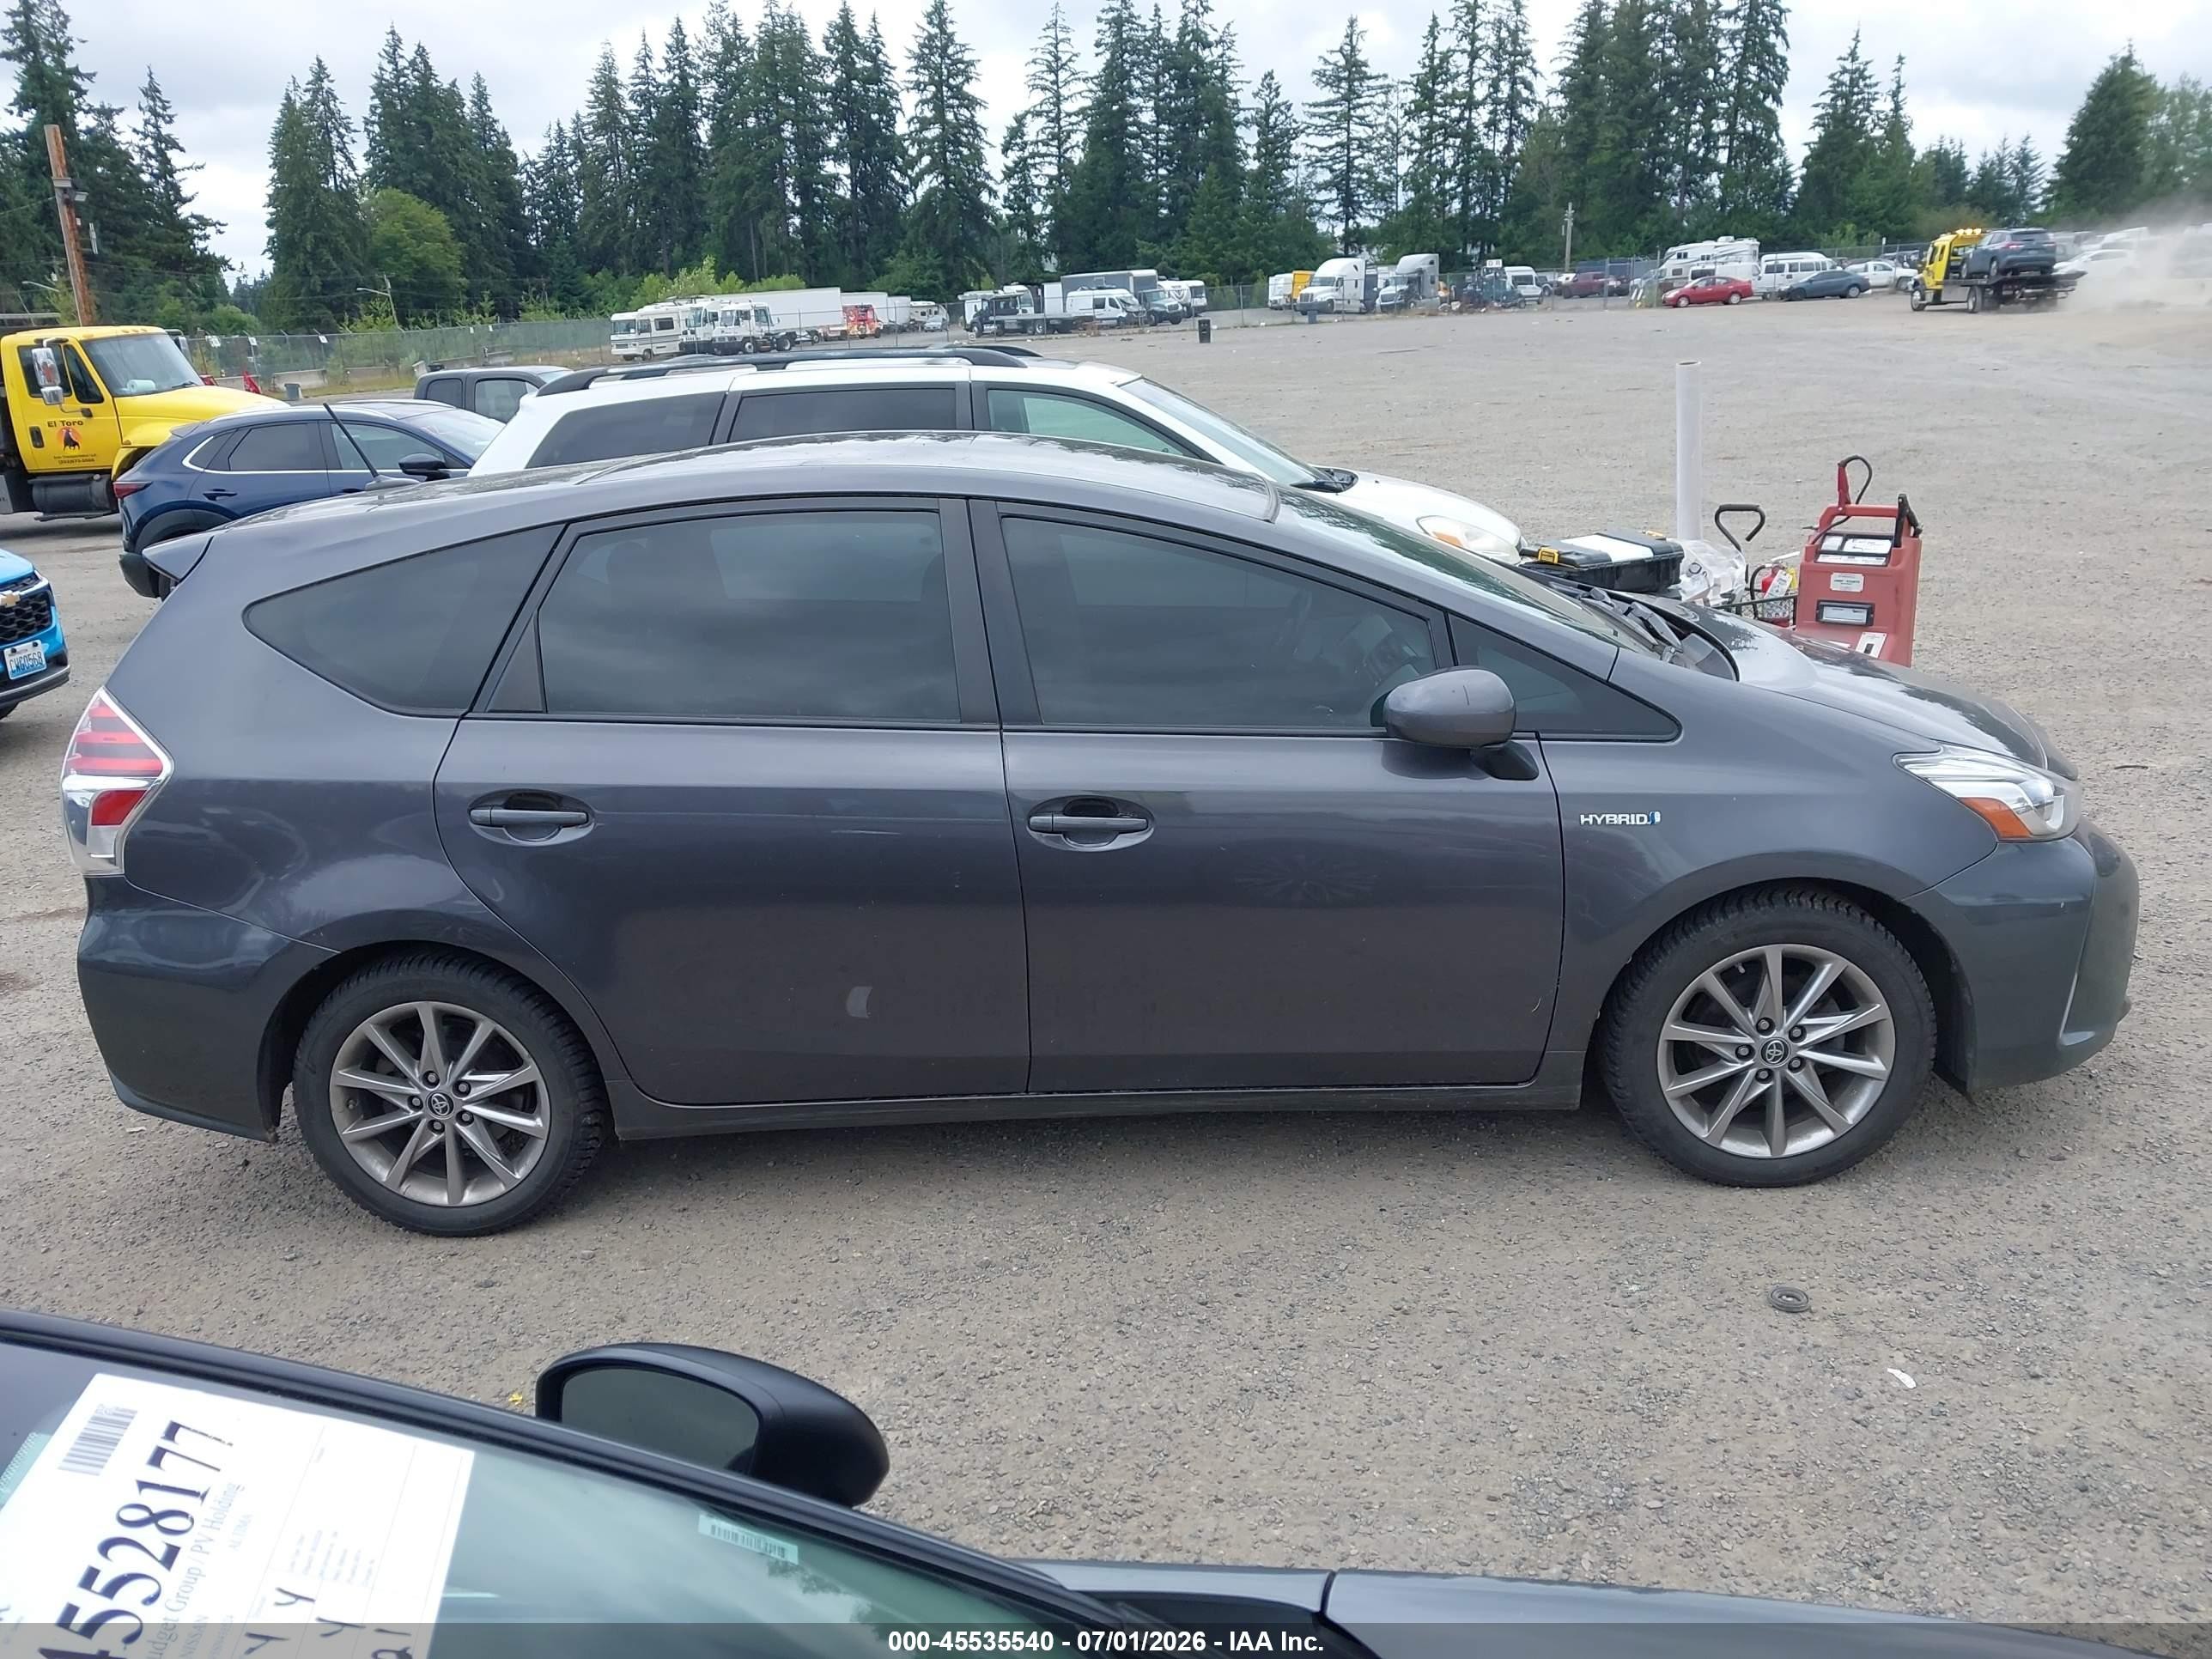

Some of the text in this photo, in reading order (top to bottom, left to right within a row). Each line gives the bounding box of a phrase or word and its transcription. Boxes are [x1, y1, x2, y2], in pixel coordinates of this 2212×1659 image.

[1580, 813, 1650, 825] HYBRID
[164, 1566, 206, 1612] Group
[191, 1531, 215, 1555] PV
